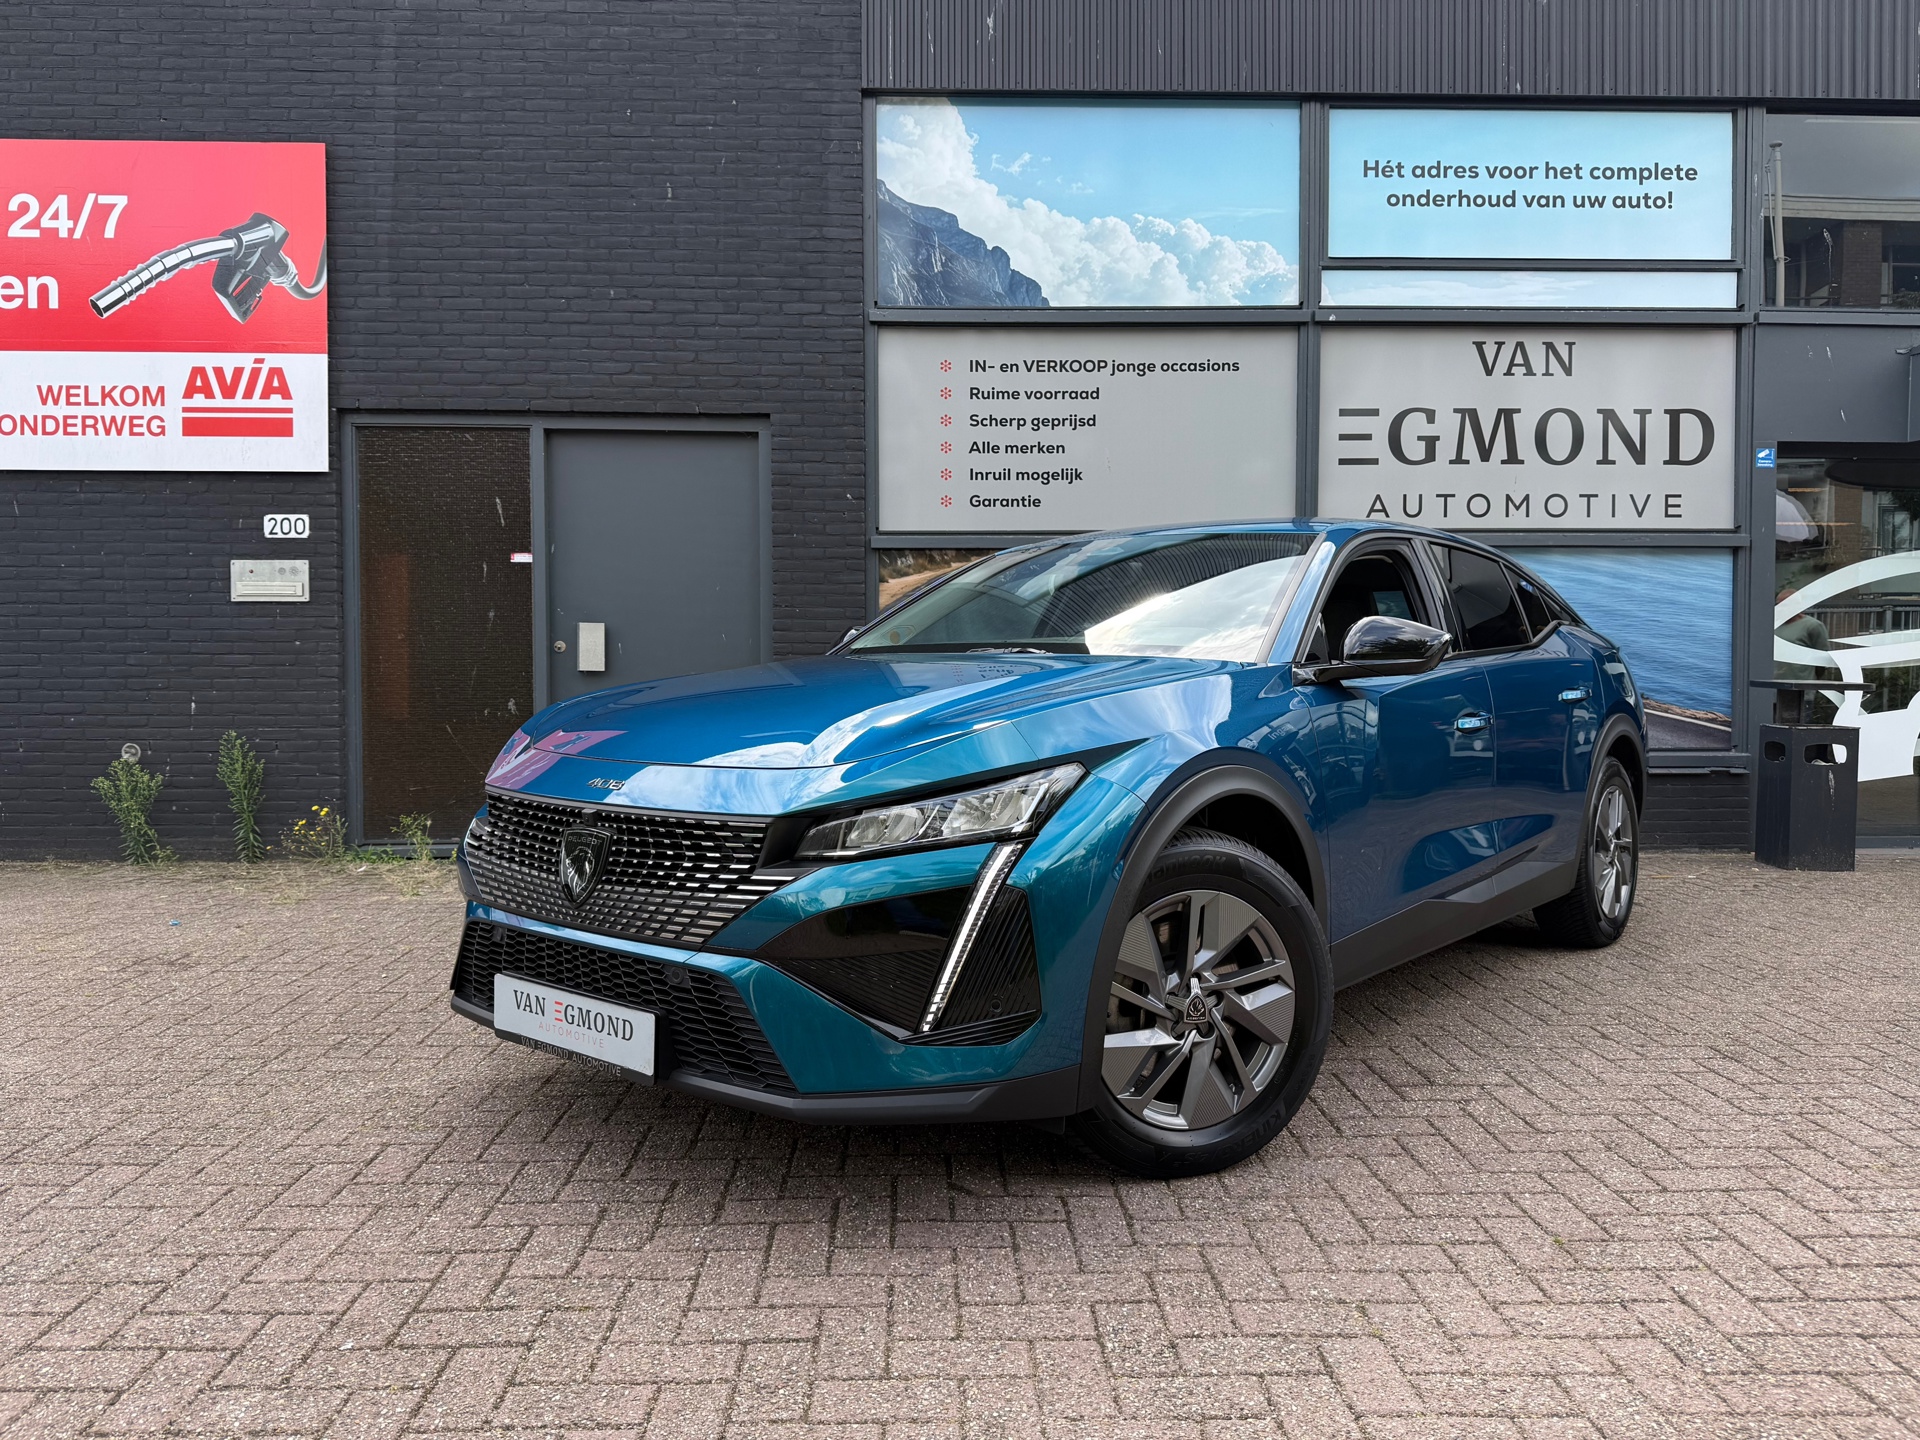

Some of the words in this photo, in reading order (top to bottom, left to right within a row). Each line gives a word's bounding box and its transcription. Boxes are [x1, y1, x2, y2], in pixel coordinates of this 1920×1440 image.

[1363, 159, 1405, 179] Hét
[1411, 160, 1480, 179] adres
[1485, 165, 1540, 180] voor
[1544, 161, 1583, 180] het
[1589, 162, 1698, 186] complete
[1386, 188, 1517, 208] onderhoud
[1523, 194, 1566, 209] van
[1572, 195, 1607, 209] uw
[1612, 190, 1673, 210] auto!
[7, 192, 129, 240] 24/7
[969, 359, 996, 373] IN-
[999, 363, 1020, 373] en
[1023, 359, 1108, 373] VERKOOP
[1110, 359, 1157, 377] jonge
[1160, 358, 1240, 373] occasions
[1472, 340, 1577, 377] VAN
[36, 384, 166, 407] WELKOM
[969, 386, 1021, 400] Ruime
[1023, 386, 1100, 400] voorraad
[0, 413, 166, 437] ONDERWEG
[969, 413, 1027, 431] Scherp
[1030, 413, 1096, 432] geprijsd
[968, 441, 1001, 454] Alle
[1004, 441, 1066, 454] merken
[1337, 407, 1715, 467] EGMOND
[969, 467, 1011, 481] Inruil
[1015, 467, 1084, 486] mogelijk
[969, 494, 1042, 508] Garantie
[1366, 493, 1683, 519] AUTOMOTIVE
[267, 517, 307, 536] 200
[586, 777, 626, 791] 408
[568, 835, 603, 846] PEUGEOT
[513, 989, 546, 1017] VAN
[554, 1000, 634, 1042] EGMOND
[538, 1021, 605, 1049] AUTOMOTIVE
[521, 1036, 536, 1049] VAN
[537, 1042, 569, 1060] EGMOND
[572, 1053, 621, 1076] AUTOMOTIVE
